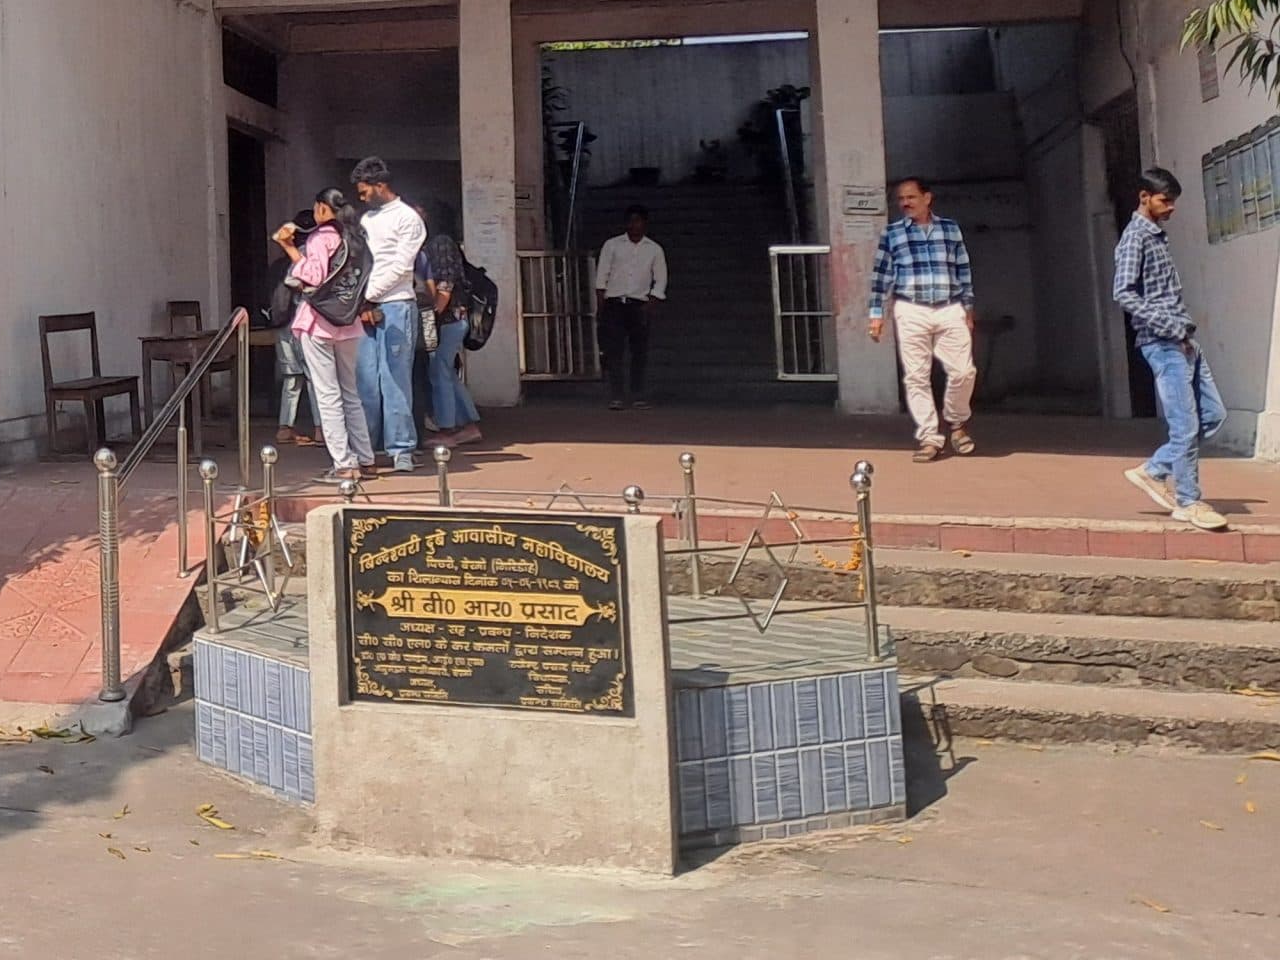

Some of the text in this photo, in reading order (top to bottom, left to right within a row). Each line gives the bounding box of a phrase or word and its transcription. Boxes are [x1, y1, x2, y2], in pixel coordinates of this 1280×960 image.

[359, 526, 610, 583] बिन्देश्वरी दुबे आवासीय महाविद्यालय
[386, 571, 404, 584] का
[464, 571, 498, 587] दिनांक
[563, 575, 580, 590] को
[391, 592, 416, 614] श्री
[520, 602, 579, 622] प्रसाद
[400, 622, 435, 634] अध्यक्ष
[524, 625, 572, 640] निदेशक
[434, 637, 448, 651] के
